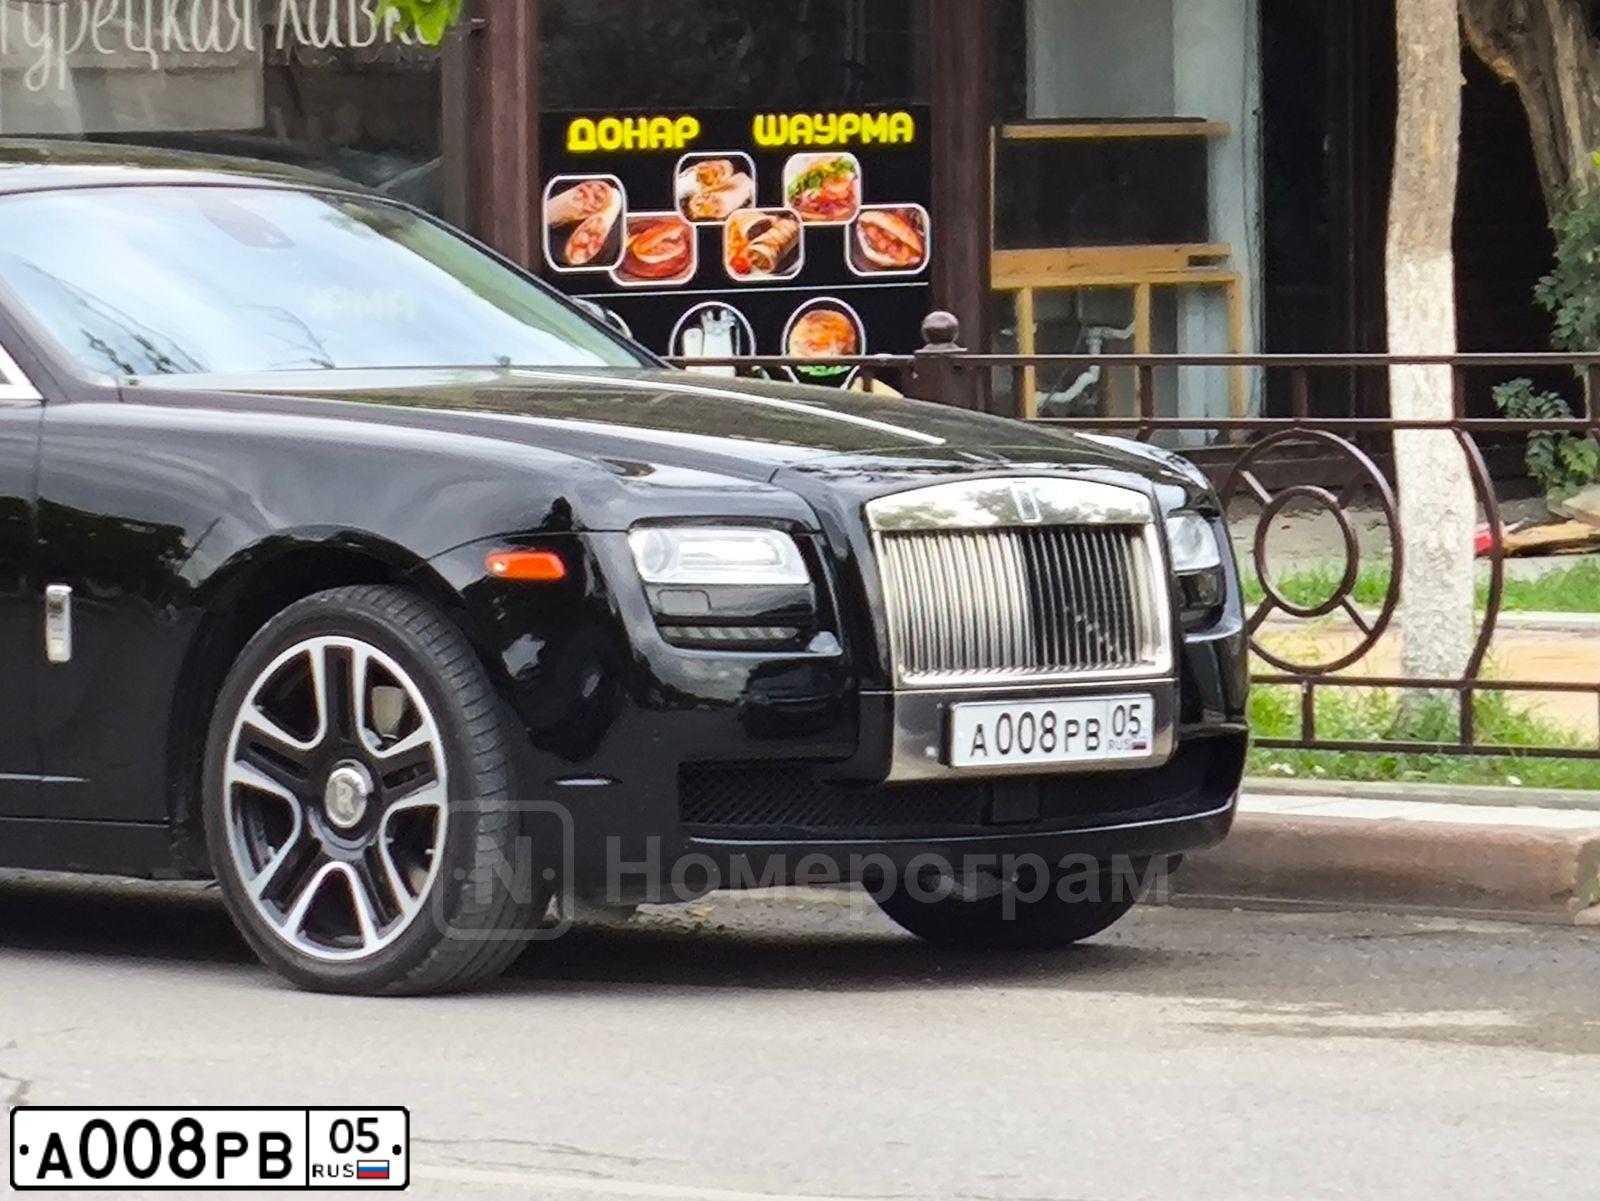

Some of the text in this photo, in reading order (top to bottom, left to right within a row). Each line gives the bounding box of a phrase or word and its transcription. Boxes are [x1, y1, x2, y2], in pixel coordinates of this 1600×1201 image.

[567, 112, 914, 151] ДОНАР ШАУРМА
[970, 704, 1141, 757] А008РВ 05
[1108, 741, 1133, 750] RUS
